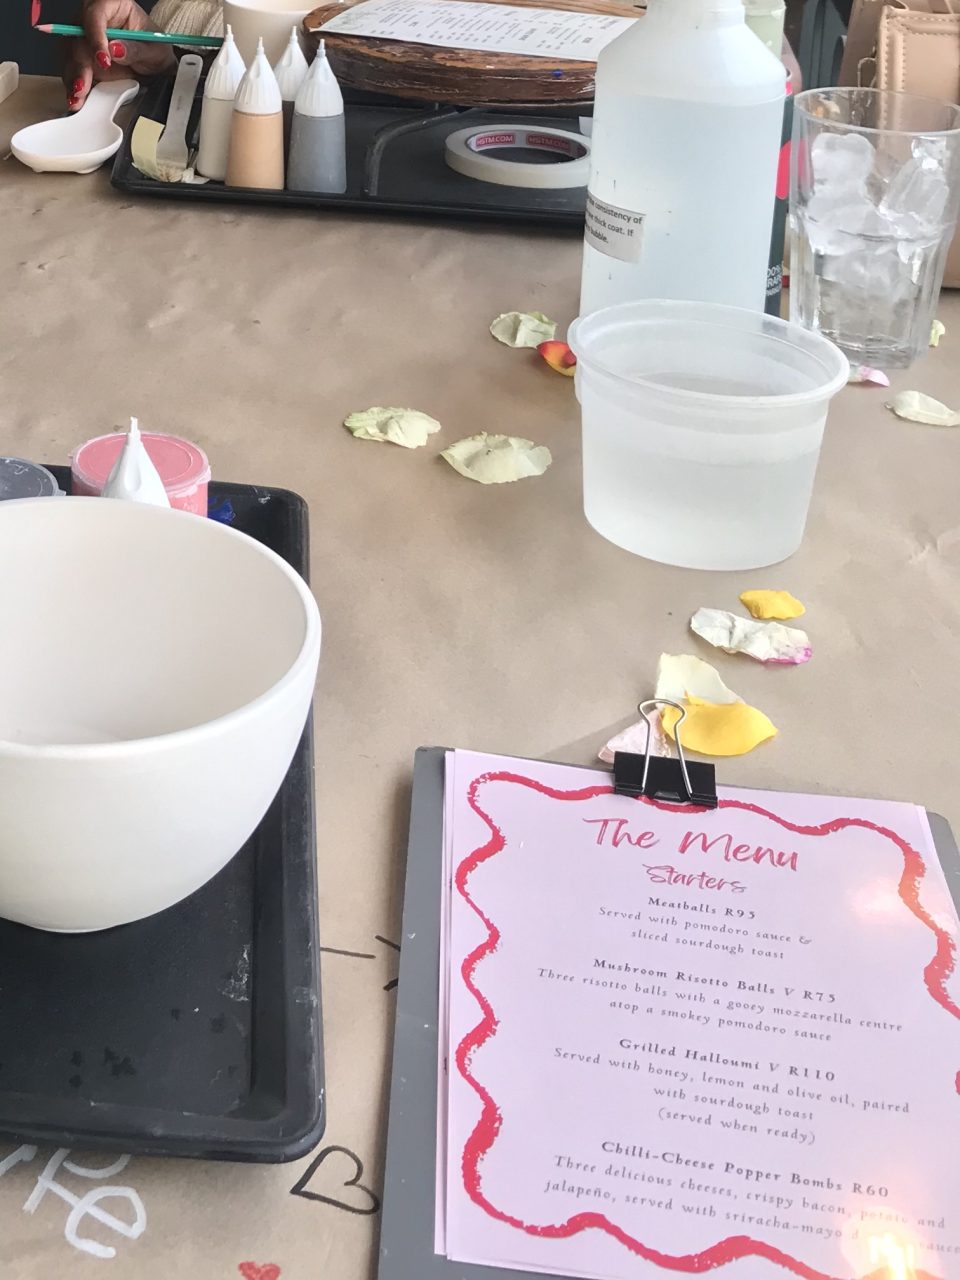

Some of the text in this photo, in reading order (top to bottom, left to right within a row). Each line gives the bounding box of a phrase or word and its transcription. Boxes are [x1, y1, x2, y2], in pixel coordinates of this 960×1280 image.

[607, 223, 625, 235] coat.
[628, 229, 635, 237] If
[633, 217, 643, 225] of
[582, 818, 799, 871] The Menu
[642, 863, 747, 894] Starters
[598, 907, 812, 945] Served with pomodoro sauce &
[648, 897, 717, 914] Meatballs
[632, 929, 784, 959] sliced sourdough toast
[538, 968, 575, 982] Three
[583, 977, 627, 990] risotto
[635, 983, 668, 997] balls
[675, 991, 706, 1003] with
[726, 1000, 765, 1014] gooey
[773, 1006, 852, 1024] mozzarella
[860, 1019, 903, 1032] centre
[593, 958, 836, 1003] Mushroom Risotto Balls V R75
[610, 1000, 639, 1014] atop
[661, 1009, 711, 1025] smokey
[718, 1017, 786, 1034] pomodoro
[794, 1029, 832, 1041] sauce
[554, 1047, 910, 1113] Served with honey, lemon and olive oil, paired
[619, 1039, 836, 1082] Grilled Halloumi V R110
[653, 1087, 814, 1120] with sourdough toast
[658, 1107, 816, 1145] (served when ready)
[601, 1141, 889, 1198] Chilli-Cheese Popper Bombs R60
[544, 1180, 617, 1203] jalapeño,
[625, 1194, 673, 1210] served
[682, 1204, 717, 1218] with
[726, 1210, 843, 1240] sriracha-mayo
[555, 1155, 597, 1172] Three
[605, 1164, 673, 1186] delicious
[680, 1178, 738, 1199] cheeses,
[746, 1191, 794, 1209] crispy
[802, 1197, 852, 1218] bacon,
[917, 1217, 945, 1229] and
